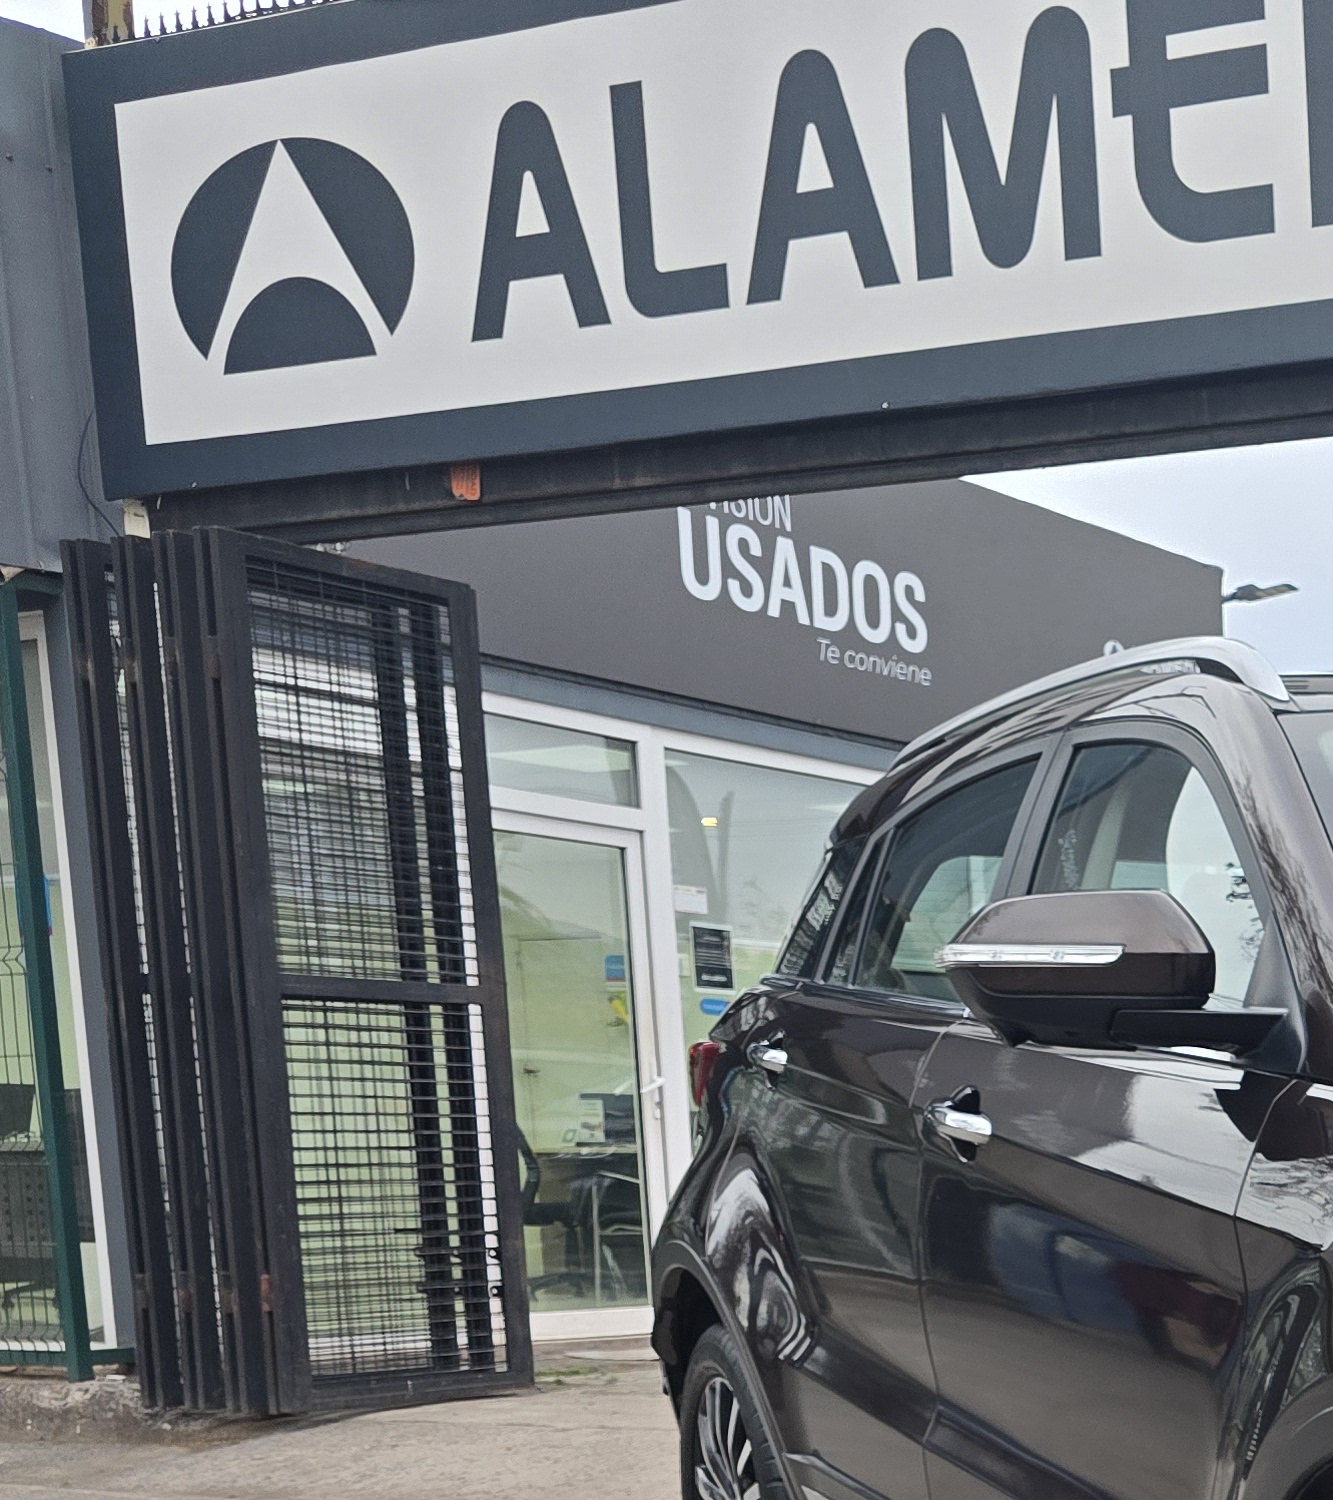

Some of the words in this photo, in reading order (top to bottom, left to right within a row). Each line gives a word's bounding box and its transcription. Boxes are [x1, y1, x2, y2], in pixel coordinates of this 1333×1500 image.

[677, 506, 929, 653] USADOS
[816, 636, 840, 664] Te
[843, 649, 932, 686] conviene
